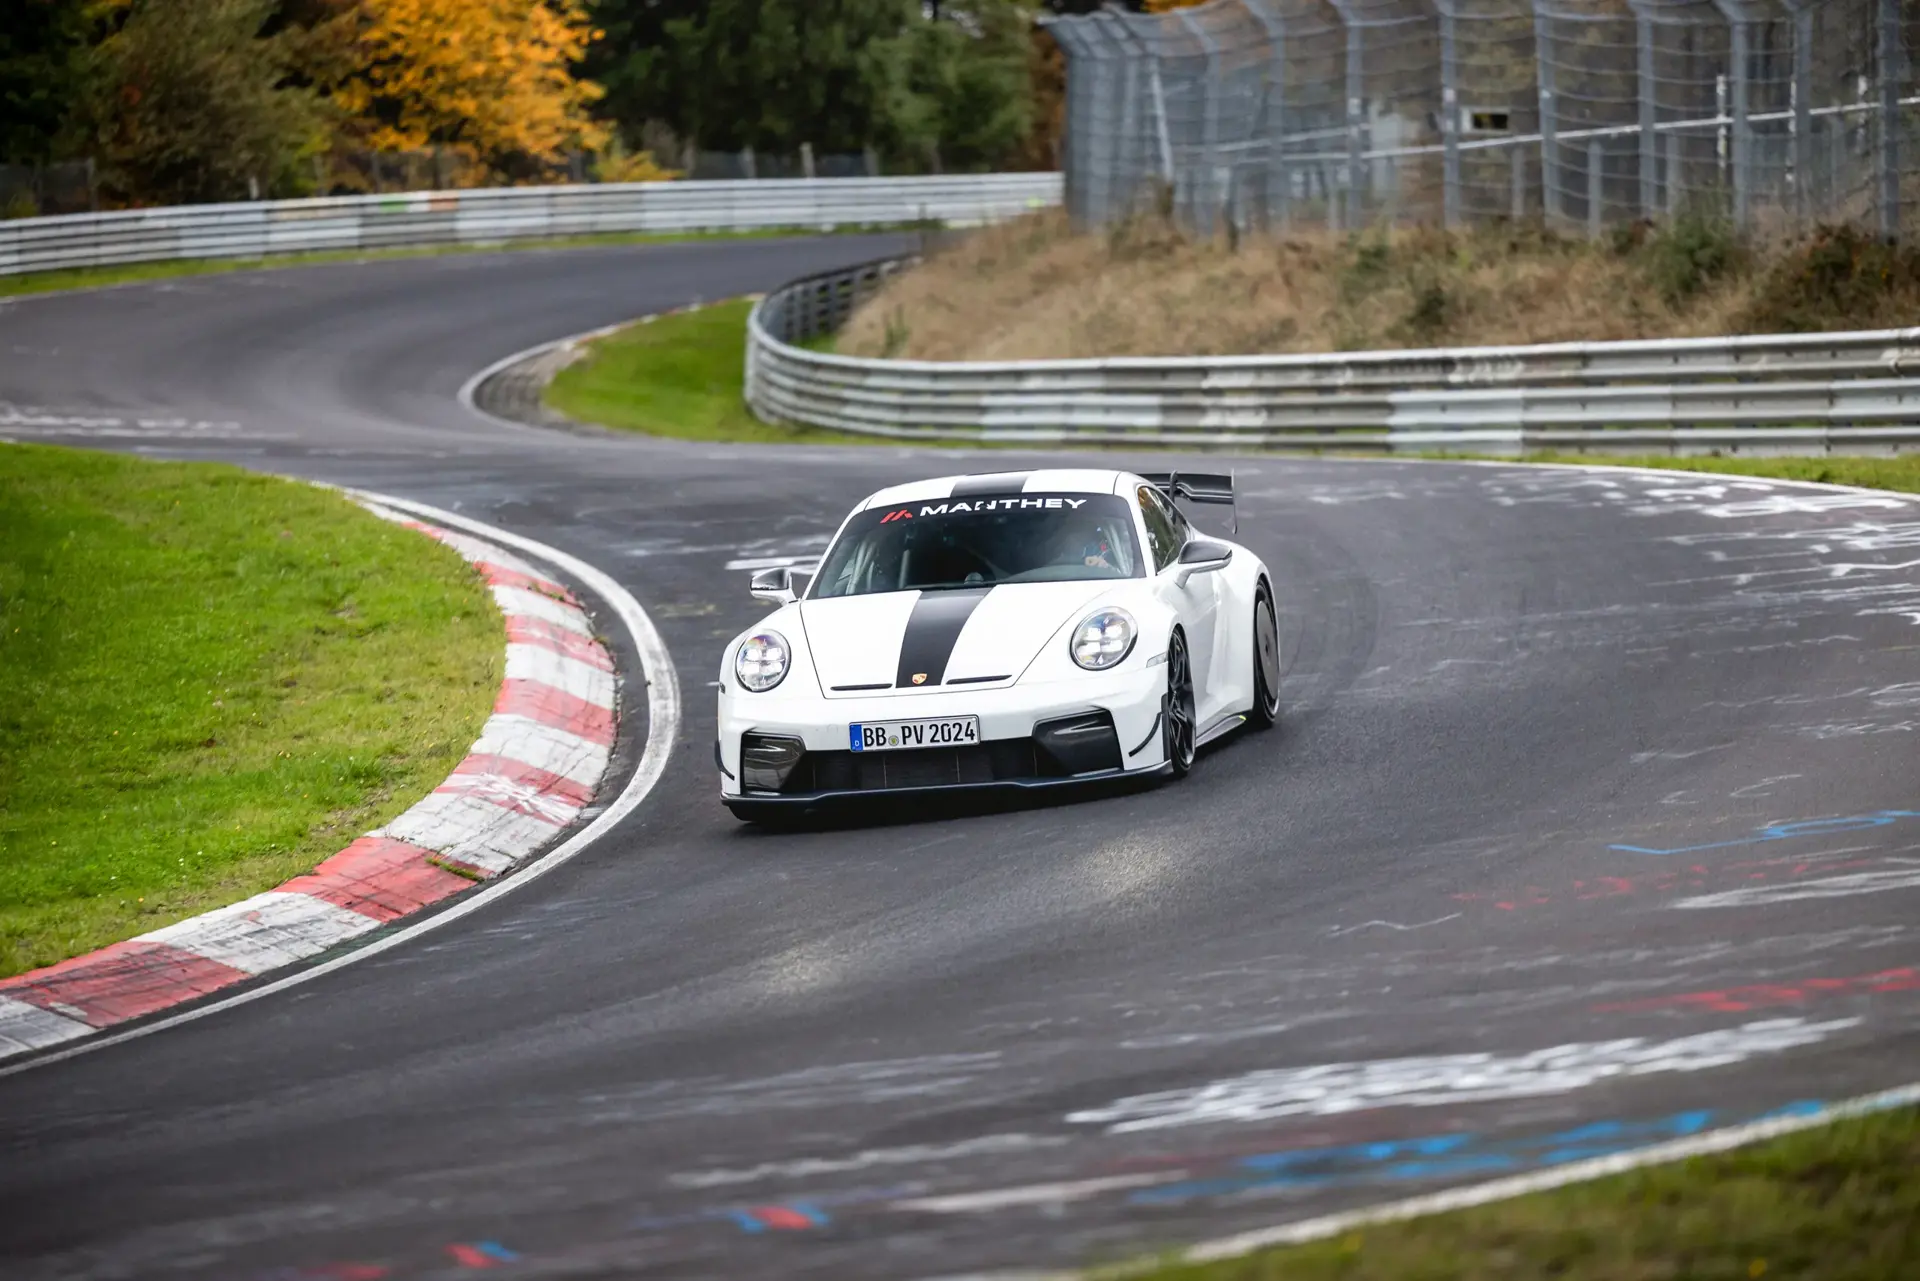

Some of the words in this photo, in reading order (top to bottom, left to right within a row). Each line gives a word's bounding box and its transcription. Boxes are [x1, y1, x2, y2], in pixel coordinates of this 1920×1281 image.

[919, 498, 1087, 517] MANTHEY
[863, 727, 887, 747] BB
[901, 725, 924, 745] PV
[929, 721, 976, 743] 2024
